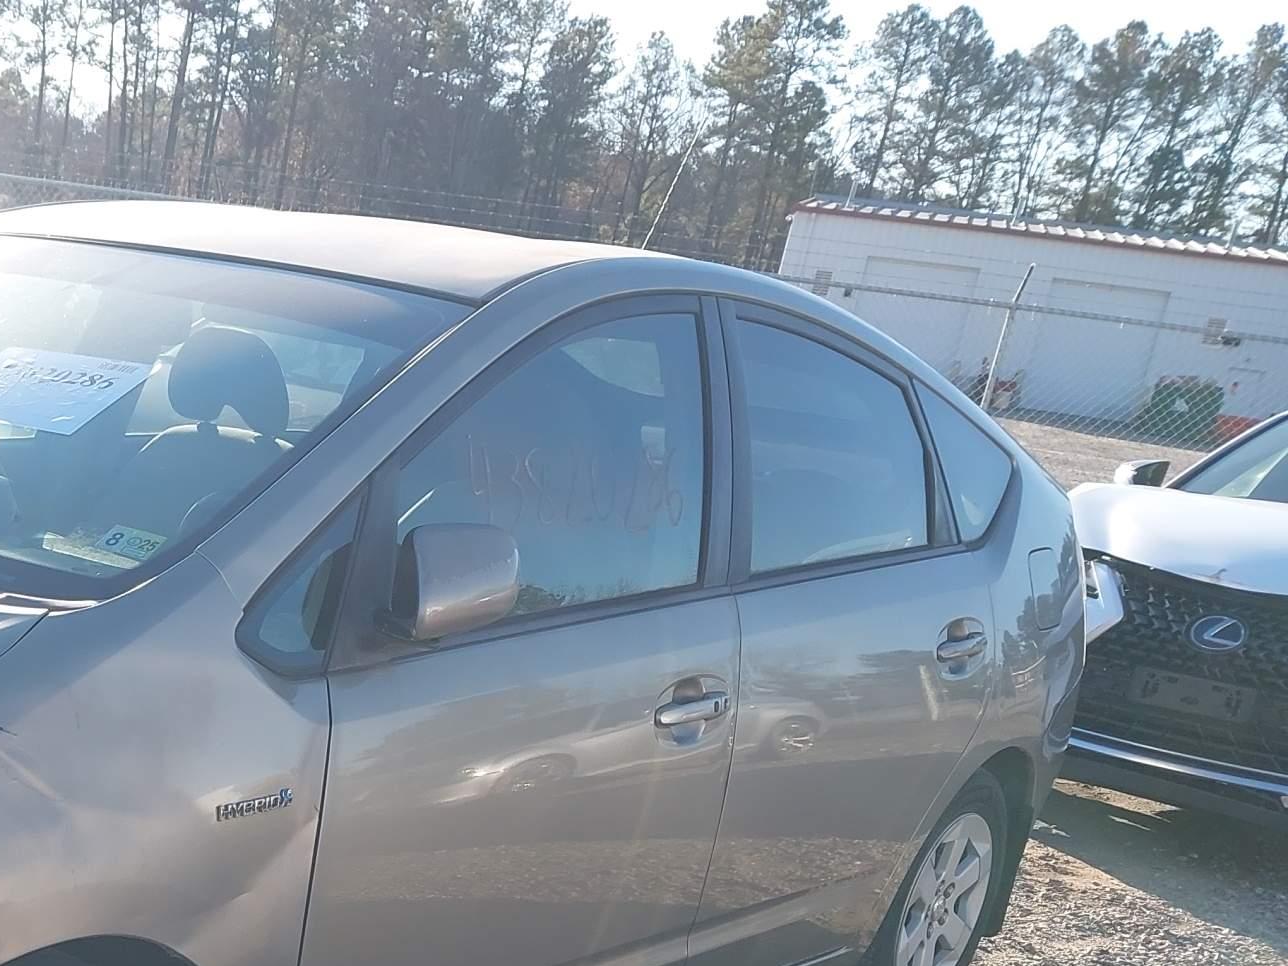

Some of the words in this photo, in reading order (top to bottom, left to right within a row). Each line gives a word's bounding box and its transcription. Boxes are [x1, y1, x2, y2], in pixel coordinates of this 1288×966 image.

[104, 532, 125, 546] 8
[137, 539, 160, 551] 25
[216, 794, 282, 821] HYBRID
